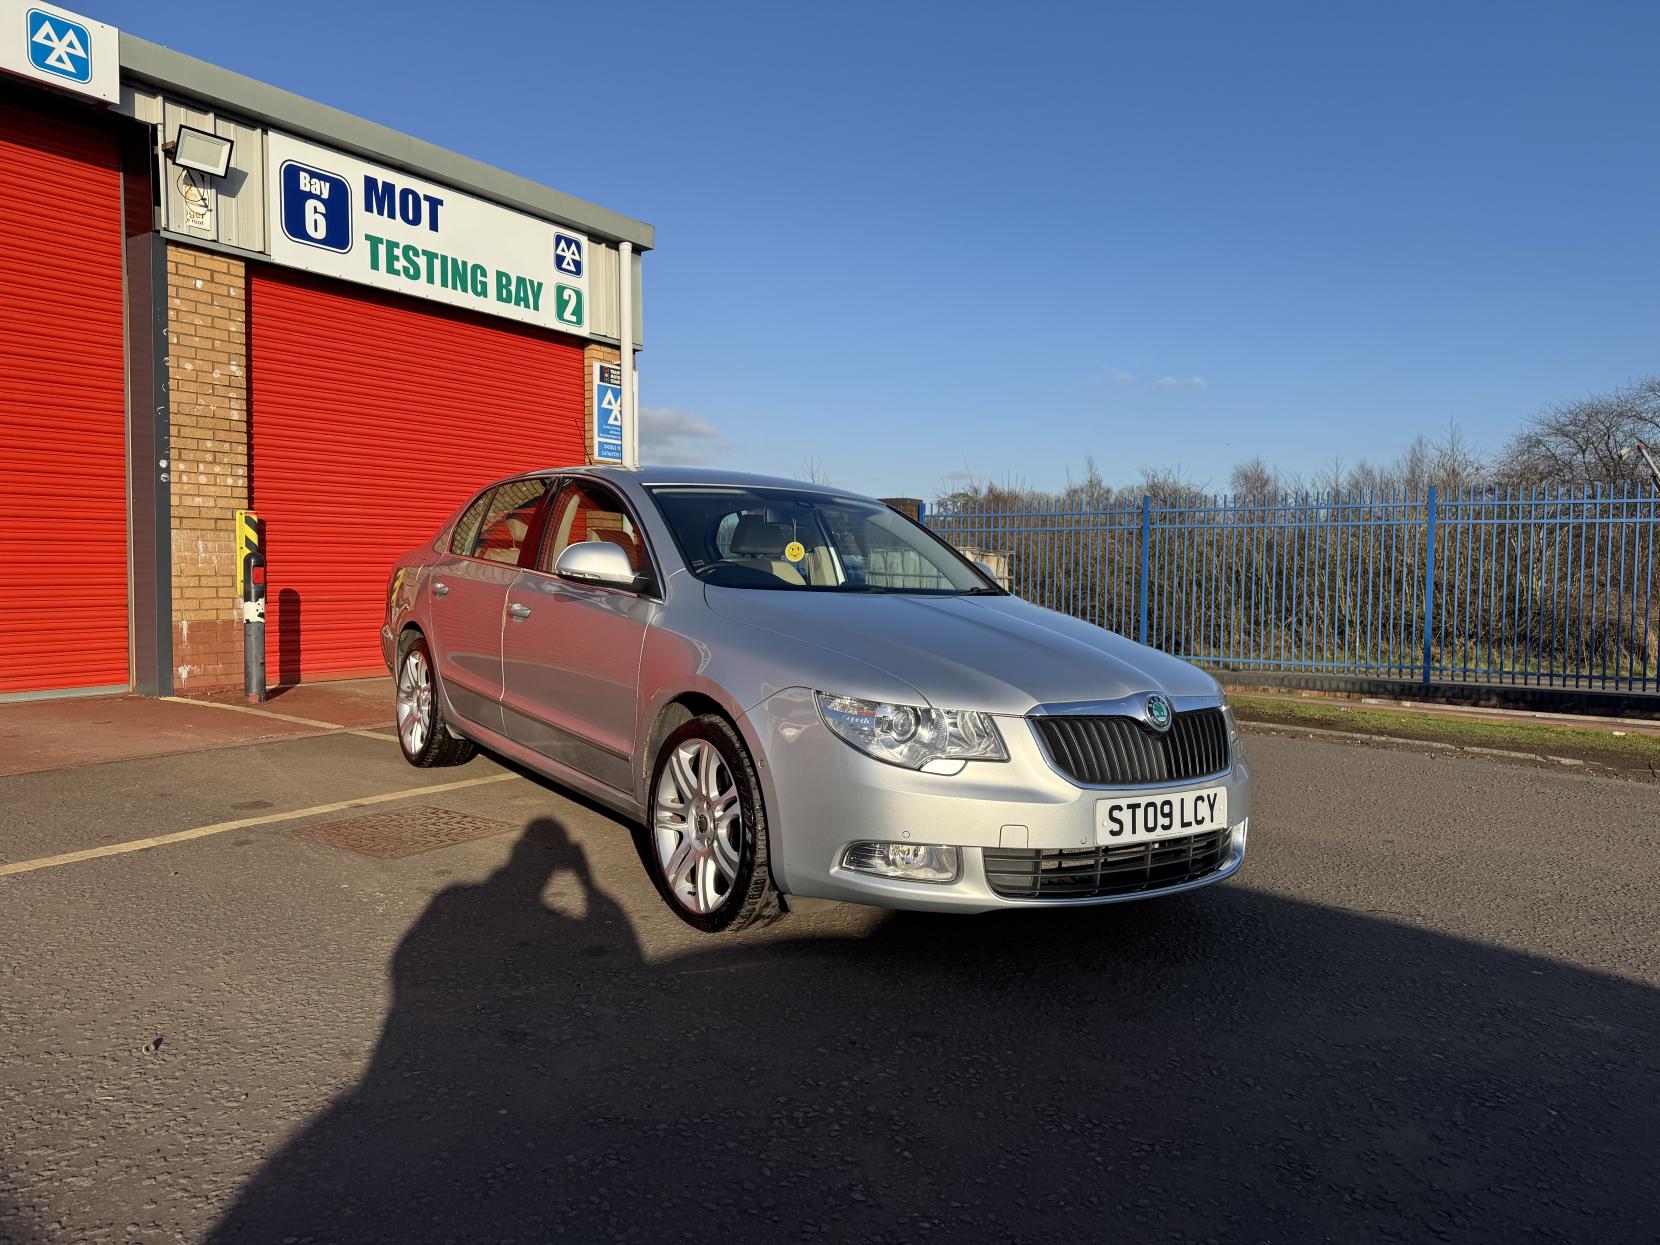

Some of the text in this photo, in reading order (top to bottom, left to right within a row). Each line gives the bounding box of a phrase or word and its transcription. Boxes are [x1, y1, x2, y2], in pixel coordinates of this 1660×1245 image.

[299, 171, 330, 200] Bay
[363, 174, 444, 233] MOT
[304, 198, 327, 240] 6
[364, 233, 577, 322] TESTING BAY 2
[1108, 792, 1218, 837] ST09 LCY
